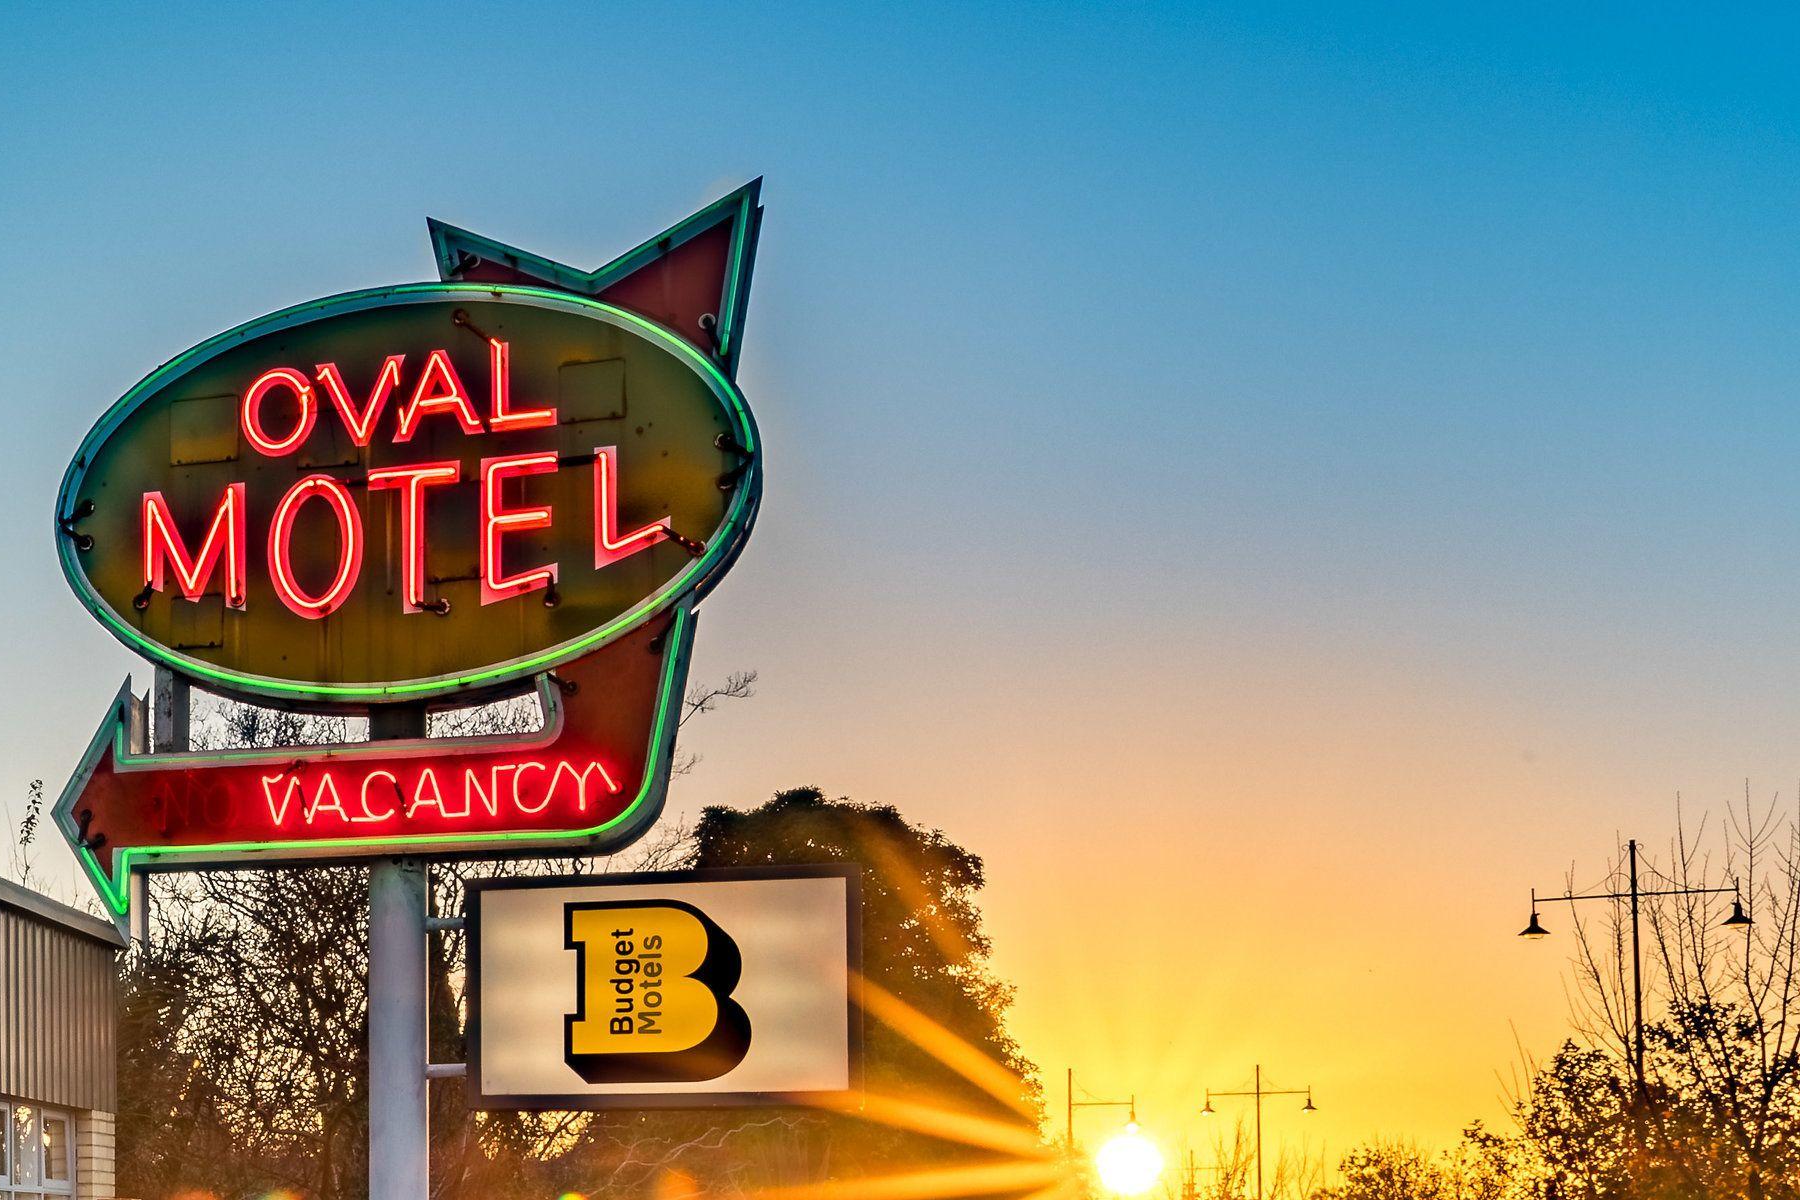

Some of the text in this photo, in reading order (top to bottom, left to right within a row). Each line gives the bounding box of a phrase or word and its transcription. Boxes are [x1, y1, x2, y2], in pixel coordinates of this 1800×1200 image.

[241, 338, 557, 457] OVAL
[143, 446, 671, 620] MOTEL
[262, 761, 618, 825] VACANCY
[610, 928, 640, 1035] Budget
[638, 935, 662, 1034] Motels
